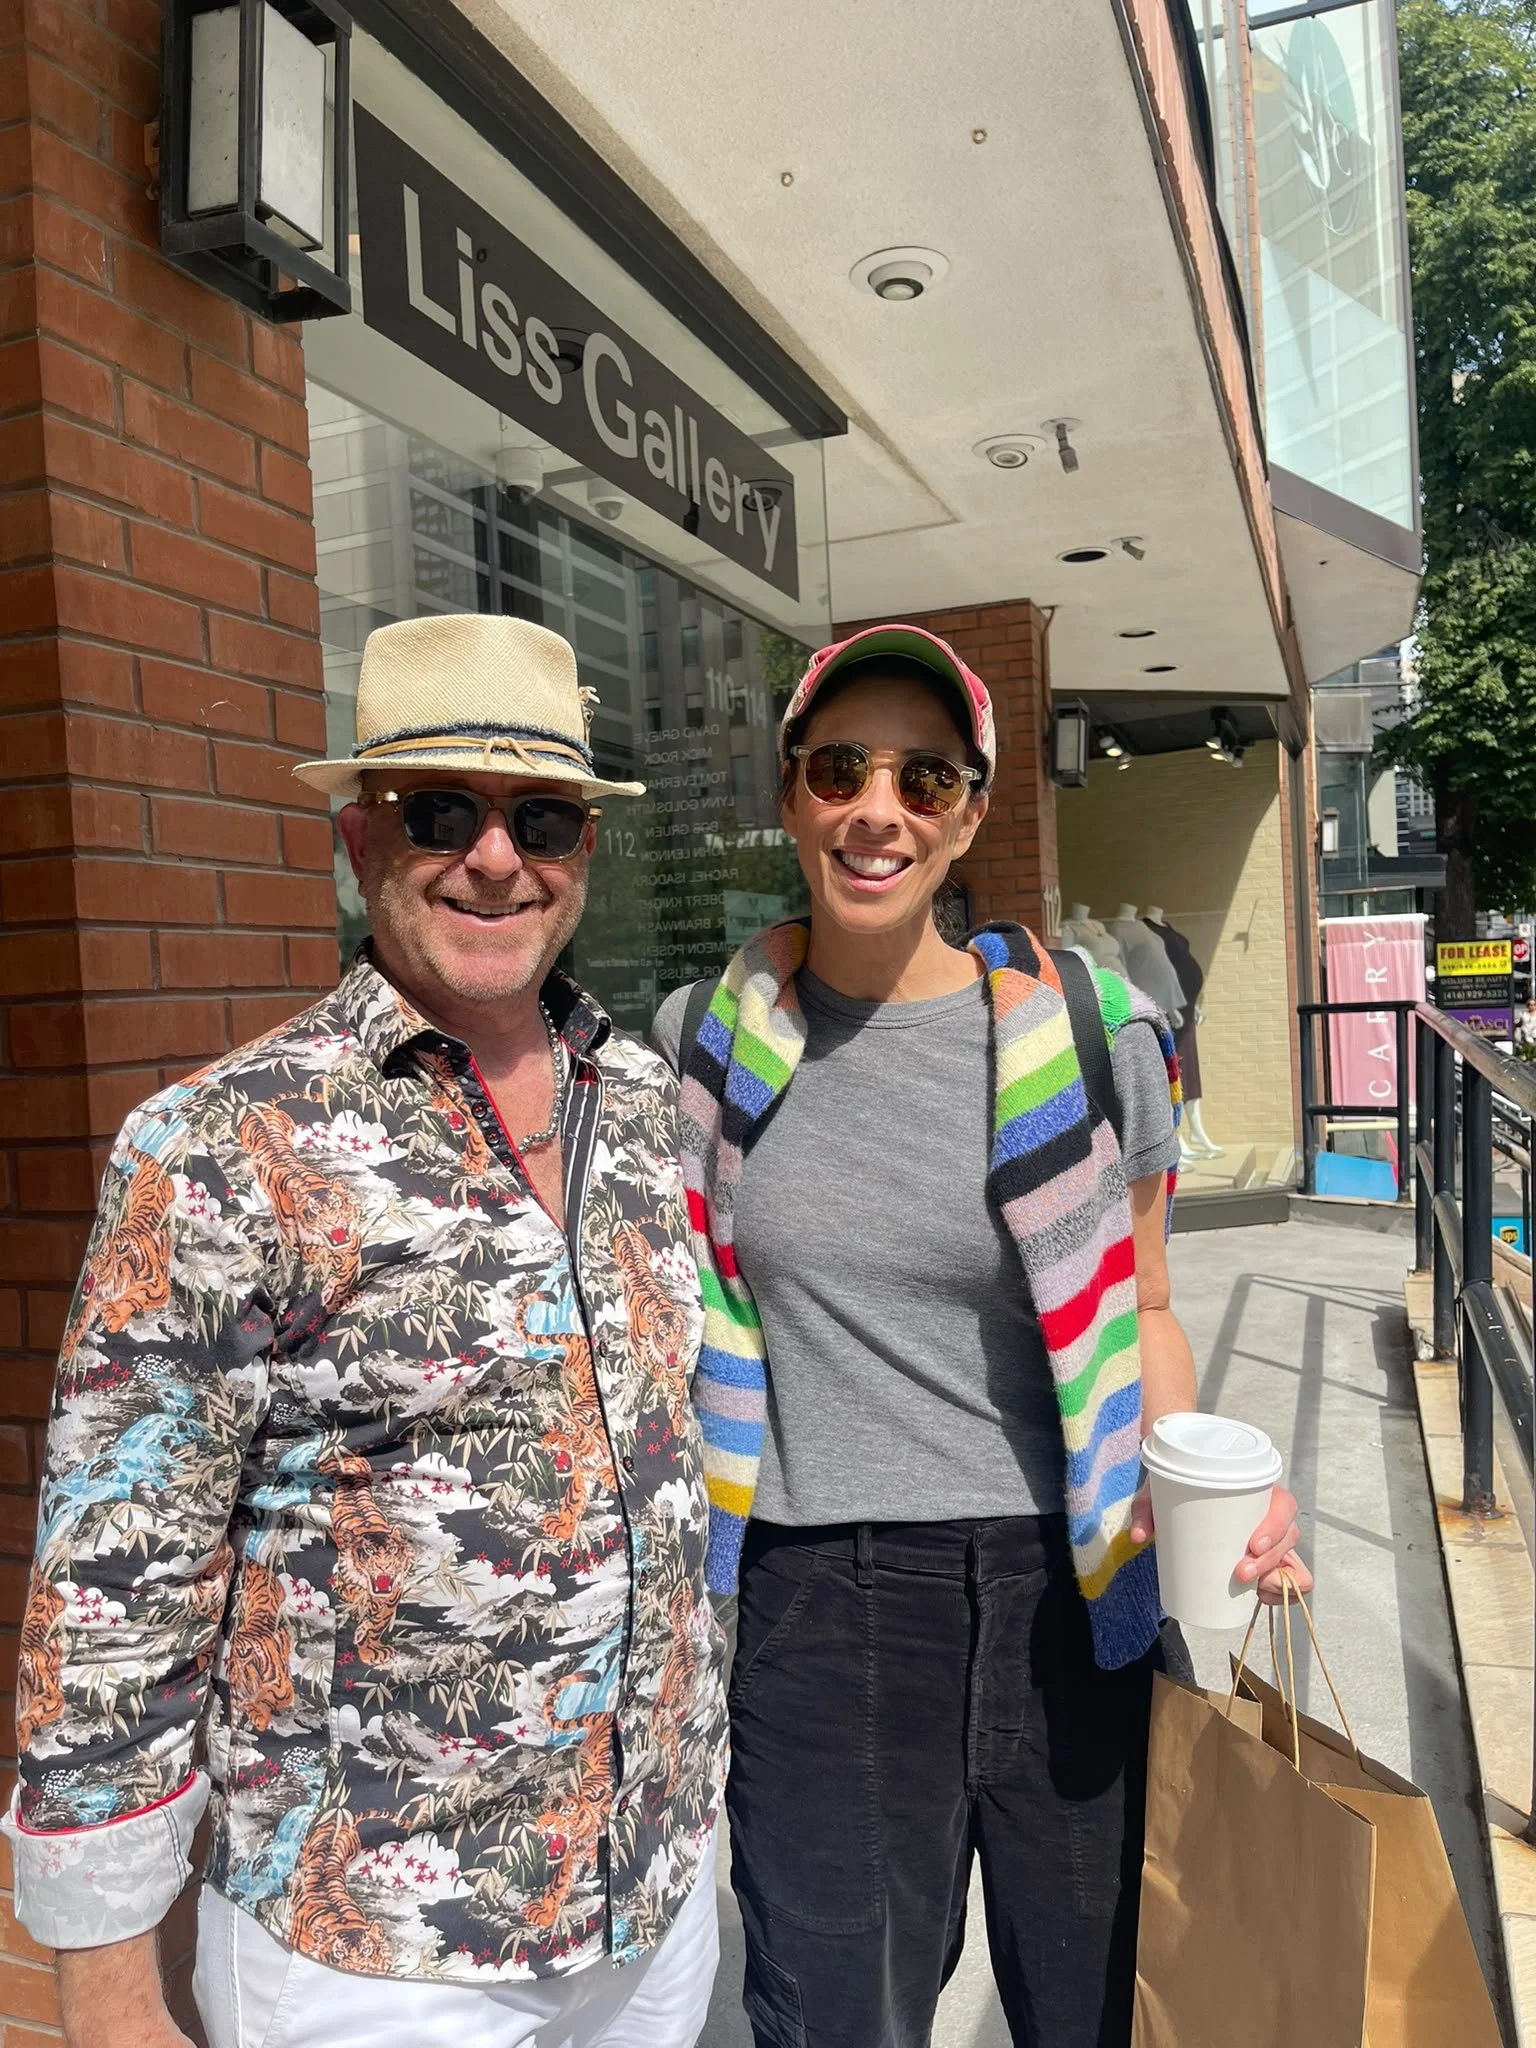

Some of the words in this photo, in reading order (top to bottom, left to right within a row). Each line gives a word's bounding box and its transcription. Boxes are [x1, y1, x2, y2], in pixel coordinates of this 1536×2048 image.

[403, 184, 563, 405] Liss
[582, 332, 781, 571] Gallery
[604, 829, 636, 858] 112
[1440, 946, 1465, 959] FOR
[1469, 944, 1508, 958] LEASE
